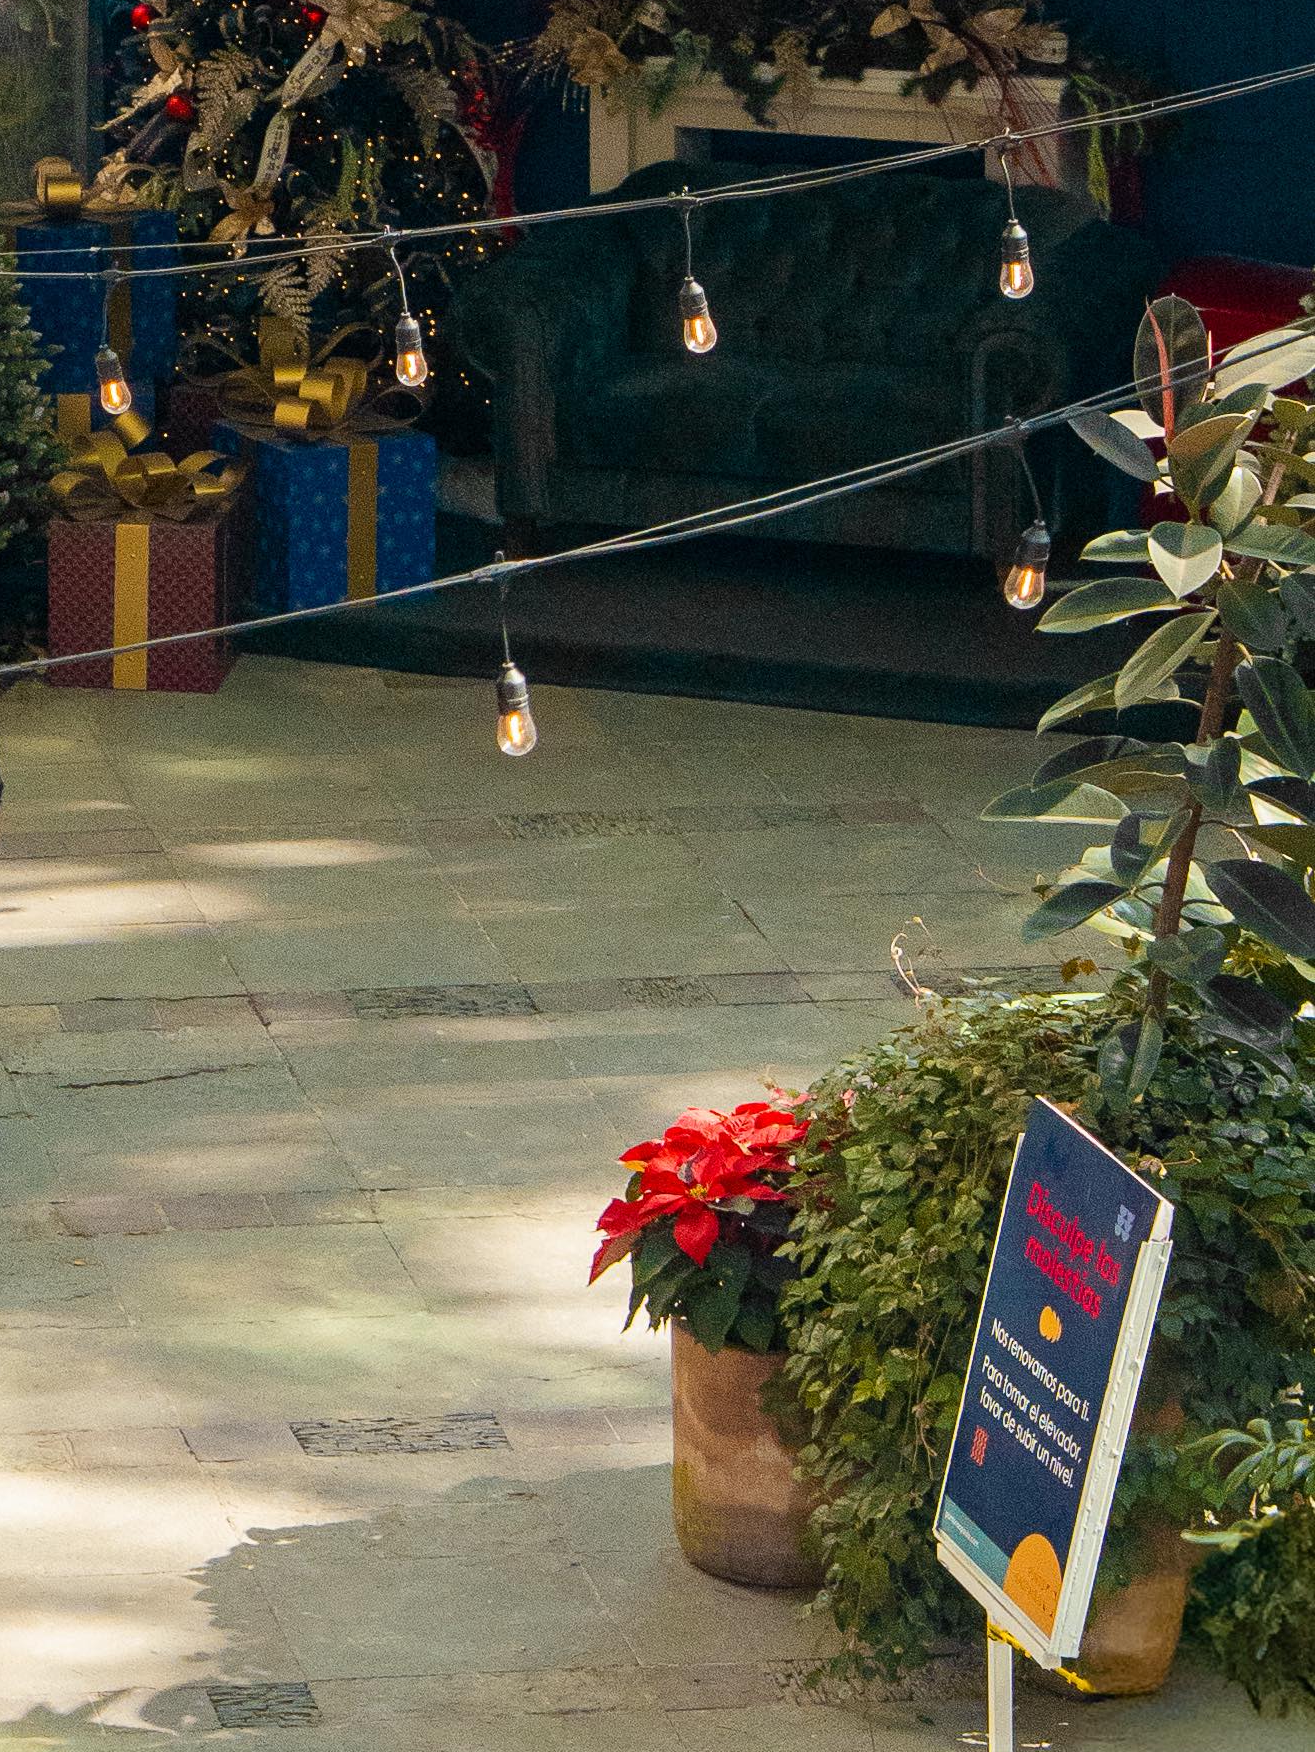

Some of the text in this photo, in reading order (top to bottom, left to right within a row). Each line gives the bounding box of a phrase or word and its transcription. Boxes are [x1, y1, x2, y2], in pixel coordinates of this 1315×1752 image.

[1024, 1236, 1103, 1320] molestias
[1026, 1180, 1121, 1286] Disculpe las
[982, 1355, 1082, 1464] Para tomar el elevador,
[991, 1317, 1090, 1421] Nos renovamos para ti.
[980, 1386, 1074, 1488] favor de subir un nivel.
